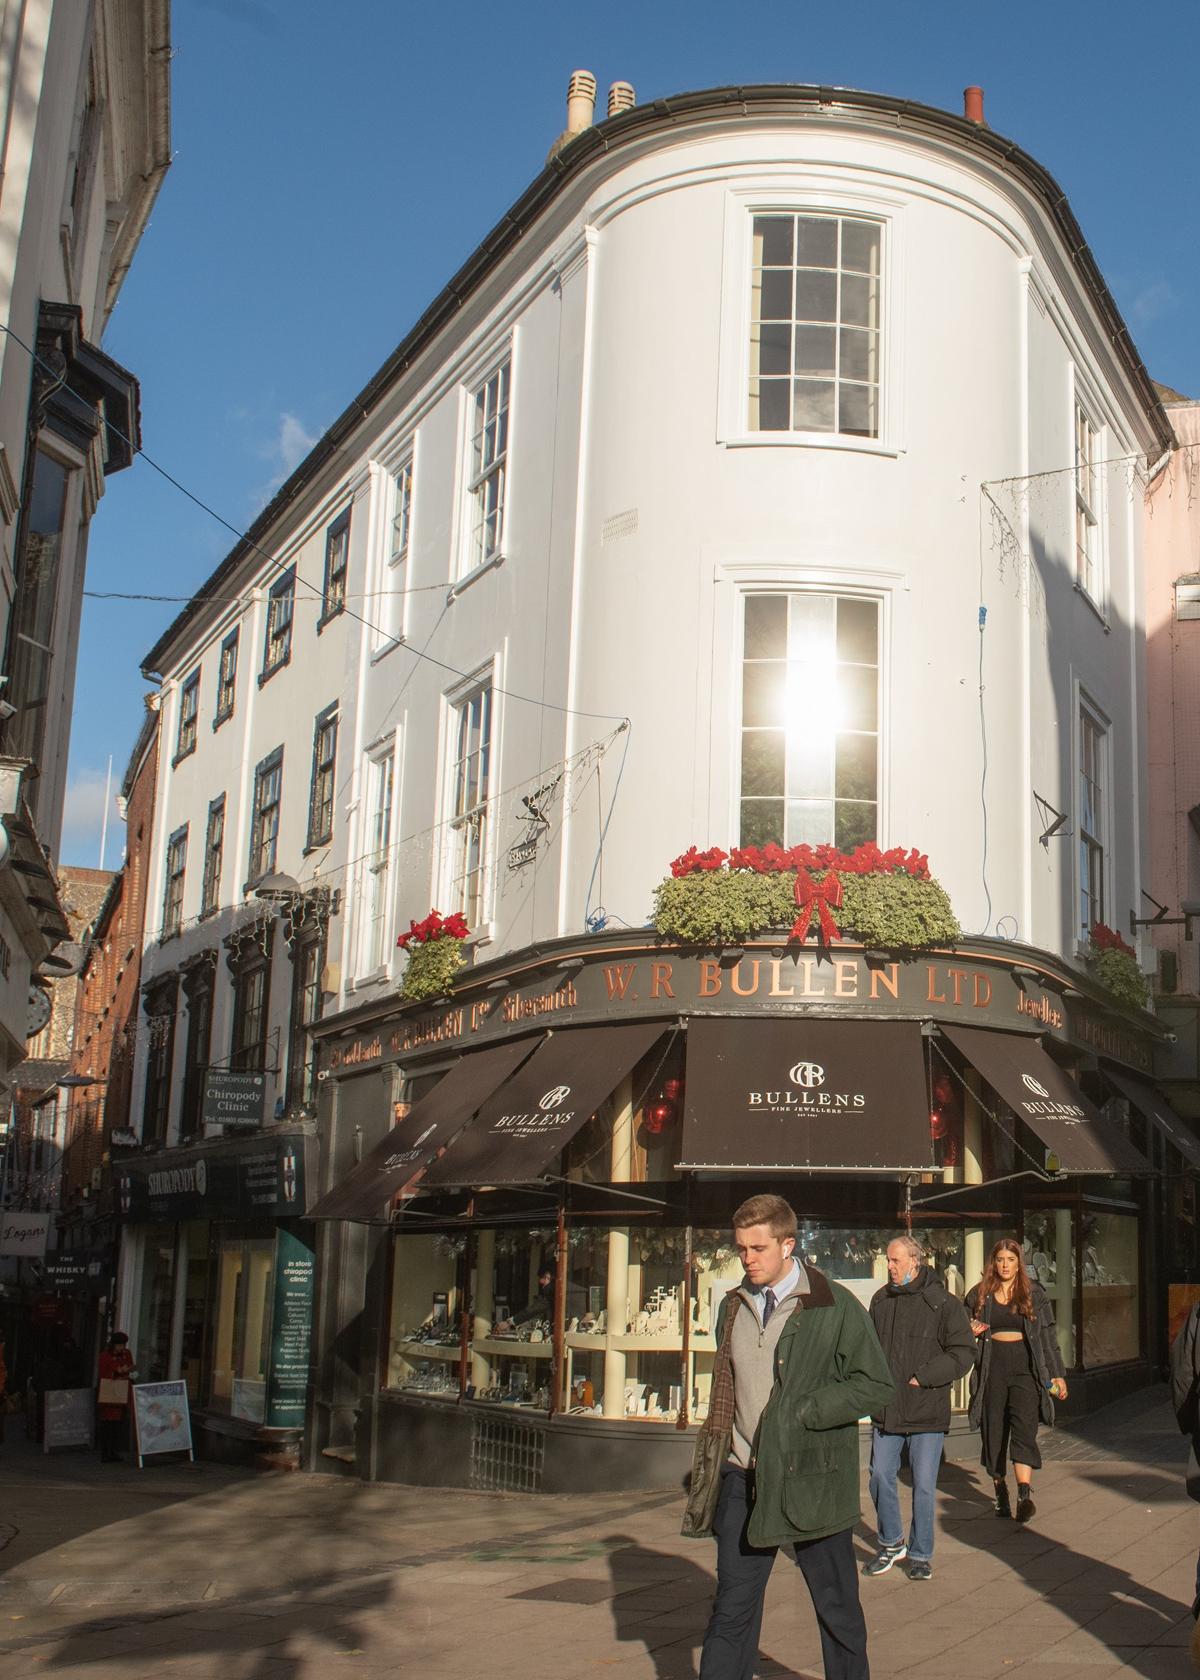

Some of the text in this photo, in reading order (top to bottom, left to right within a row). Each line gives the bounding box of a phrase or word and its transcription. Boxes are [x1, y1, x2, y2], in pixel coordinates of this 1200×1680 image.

[699, 960, 901, 1000] BULLEN
[926, 966, 992, 1008] LTD
[502, 980, 578, 1024] Silversmith
[207, 1089, 261, 1102] Chiropody
[748, 1092, 865, 1106] BULLENS
[217, 1101, 249, 1112] Clinic
[1021, 1102, 1085, 1116] BULLENS
[494, 1112, 575, 1127] BULLENS
